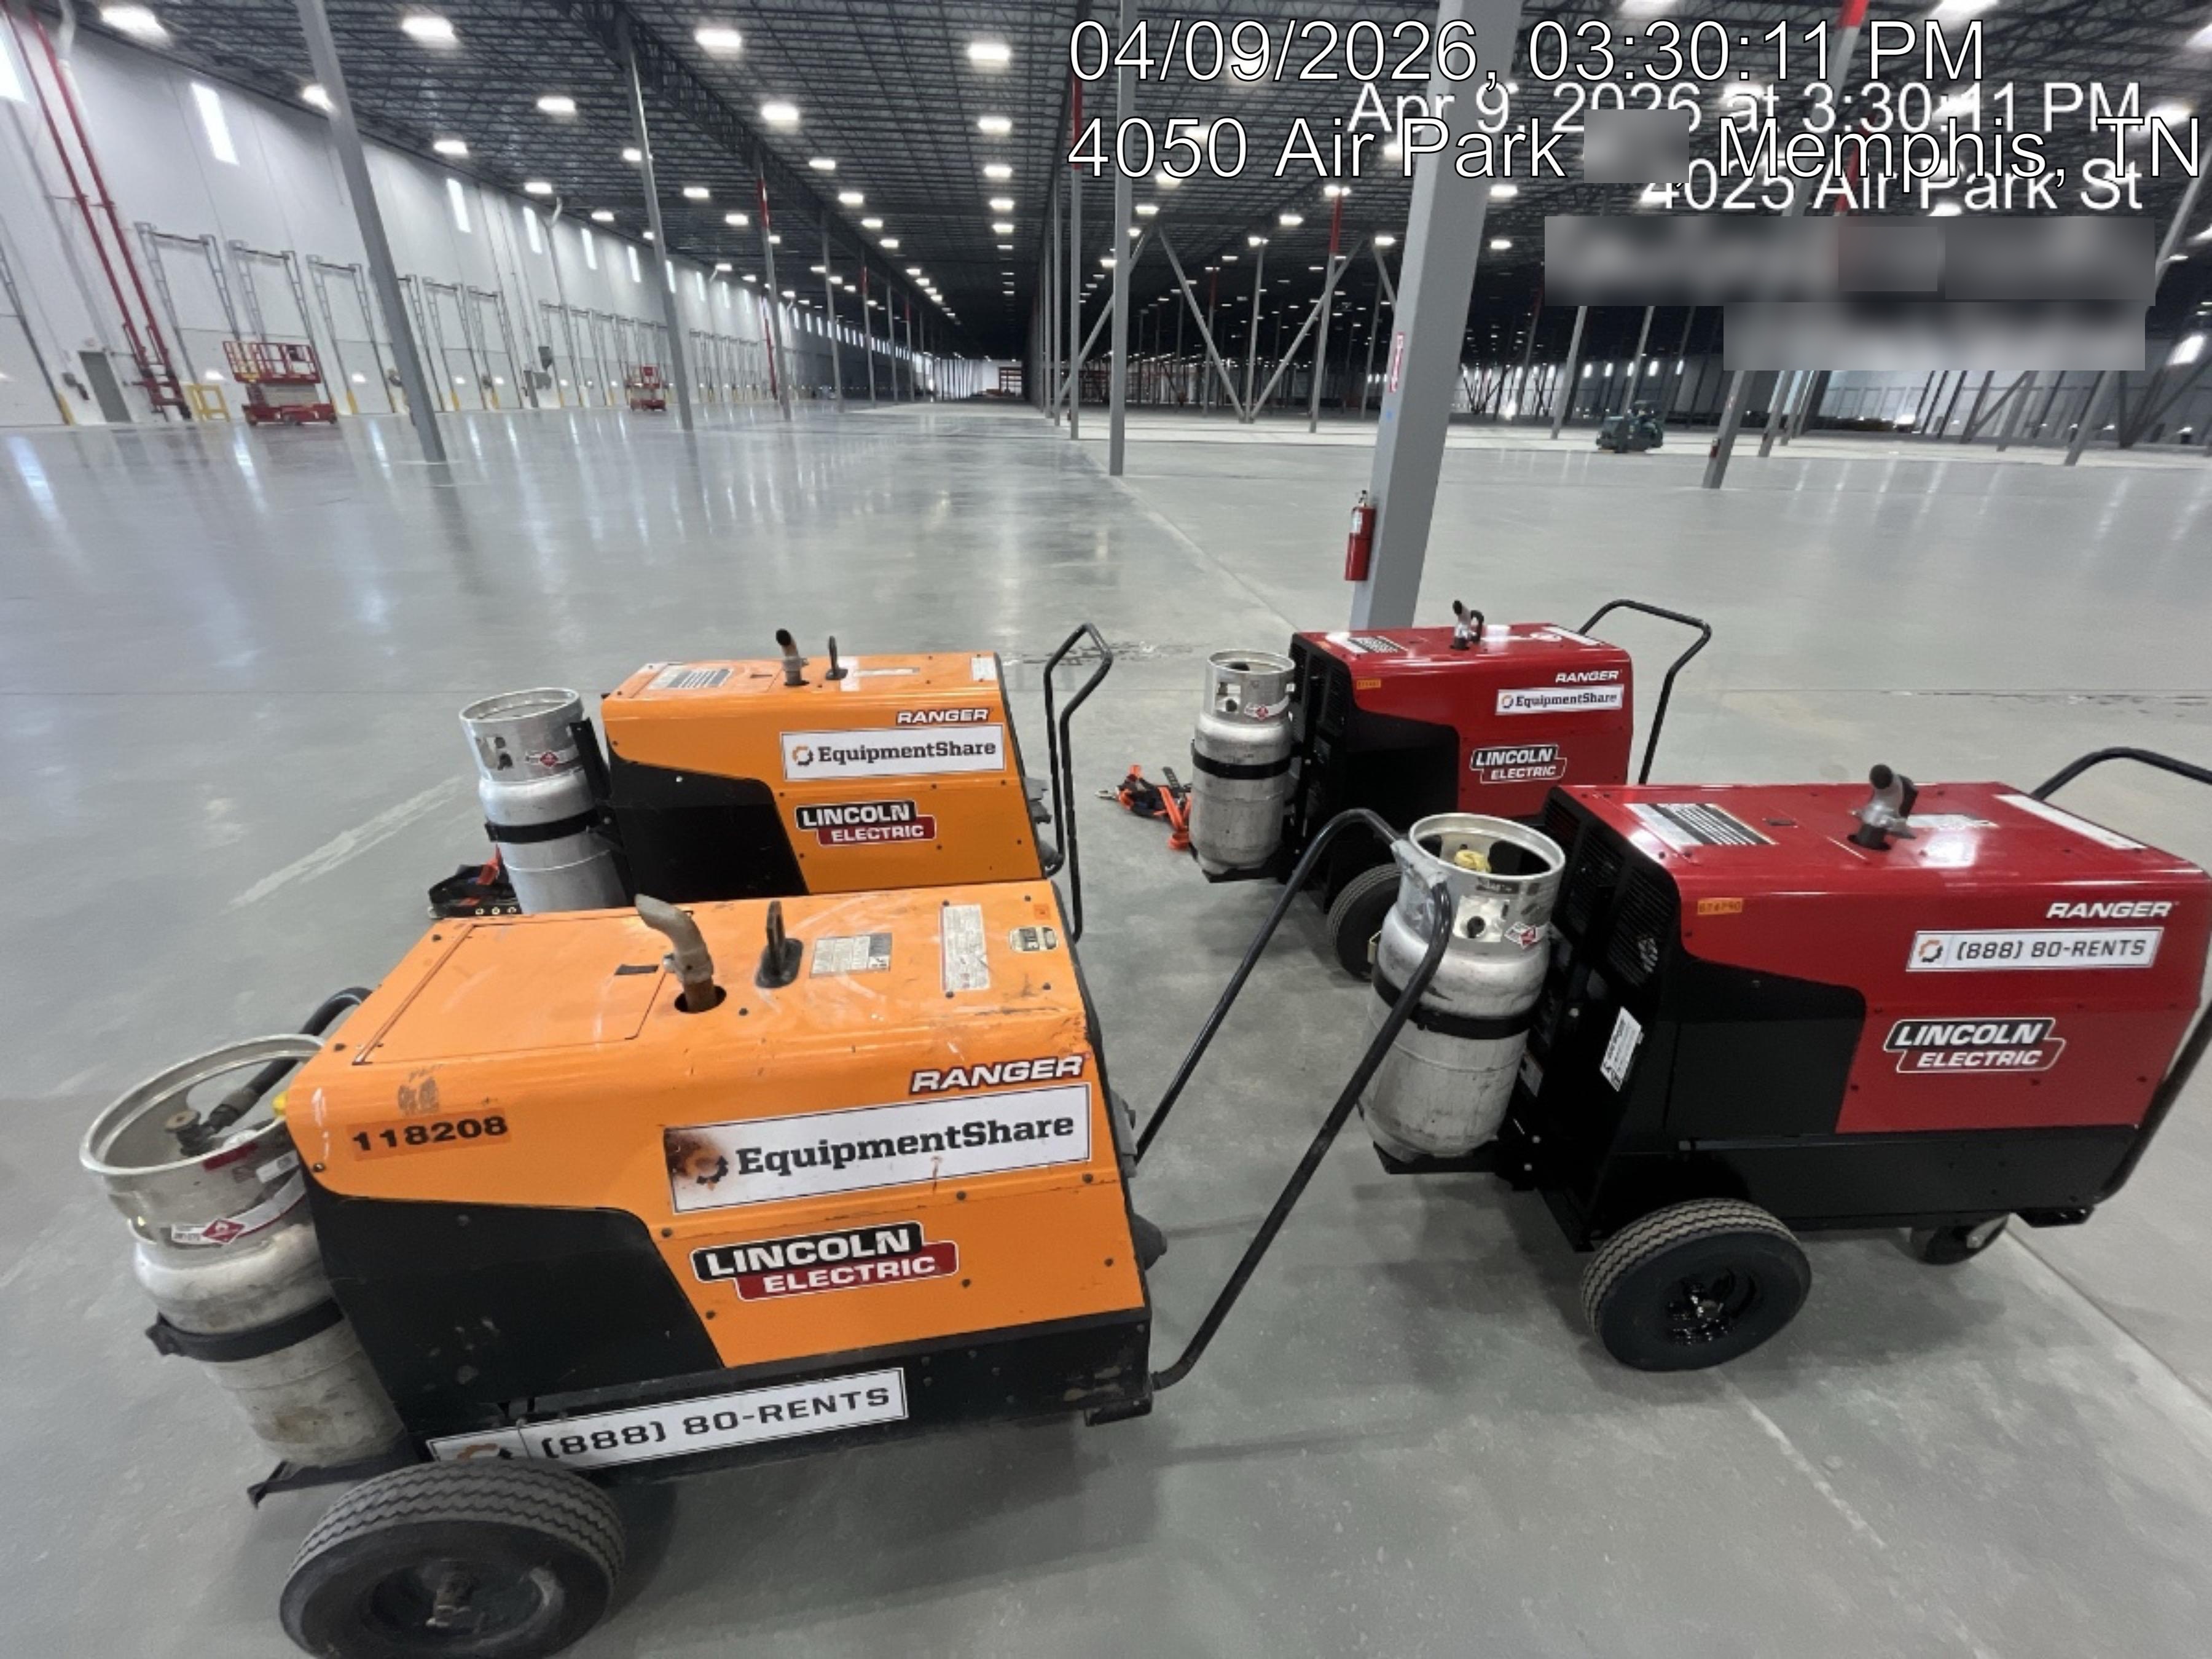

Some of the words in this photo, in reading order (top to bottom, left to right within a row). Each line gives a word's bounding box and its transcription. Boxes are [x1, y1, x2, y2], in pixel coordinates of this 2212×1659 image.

[1555, 669, 1619, 683] RANGER
[1515, 692, 1617, 708] EquipmentShare
[896, 708, 990, 724] RANGER
[818, 740, 997, 766] EquipmentShare
[1476, 747, 1553, 766] LINCOLN
[1491, 766, 1557, 781] ELECTRIC
[802, 802, 911, 827] LINCOLN
[831, 825, 925, 843] ELECTRIC
[2045, 901, 2173, 919] RANGER
[1957, 940, 2023, 961] (888)
[2030, 939, 2147, 958] 80-RENTS
[1895, 1022, 2044, 1046] LINCOLN
[1916, 1049, 2044, 1068] ELECTRIC
[910, 1054, 1084, 1094] RANGER
[352, 1115, 509, 1152] 118208
[736, 1114, 1074, 1177] EquipmentShare
[706, 1227, 912, 1277] LINCOLN
[763, 1255, 936, 1295] ELECTRIC
[541, 1419, 665, 1459] (888)
[681, 1386, 890, 1437] 80-RENTS
